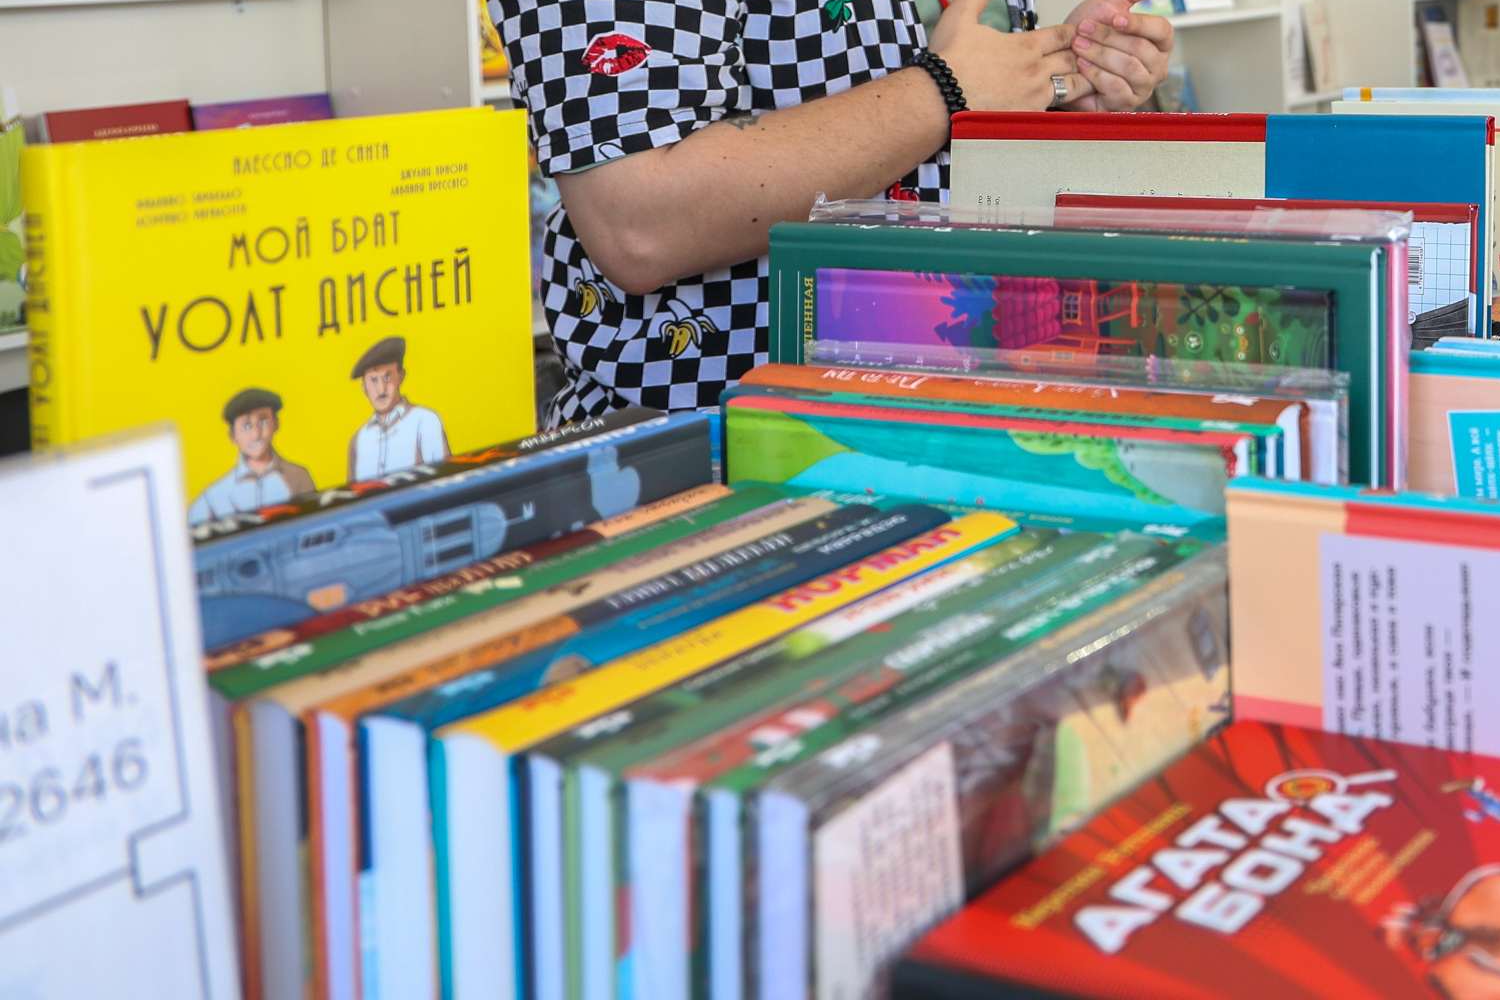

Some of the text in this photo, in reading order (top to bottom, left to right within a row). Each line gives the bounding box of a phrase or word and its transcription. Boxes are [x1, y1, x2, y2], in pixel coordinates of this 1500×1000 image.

[321, 147, 338, 170] ДЕ
[228, 210, 400, 269] МОЙ БРАТ
[140, 247, 473, 360] УОЛТ ДИСНЕЙ
[1072, 797, 1292, 954] АГАТА
[1173, 791, 1395, 935] БОНД
